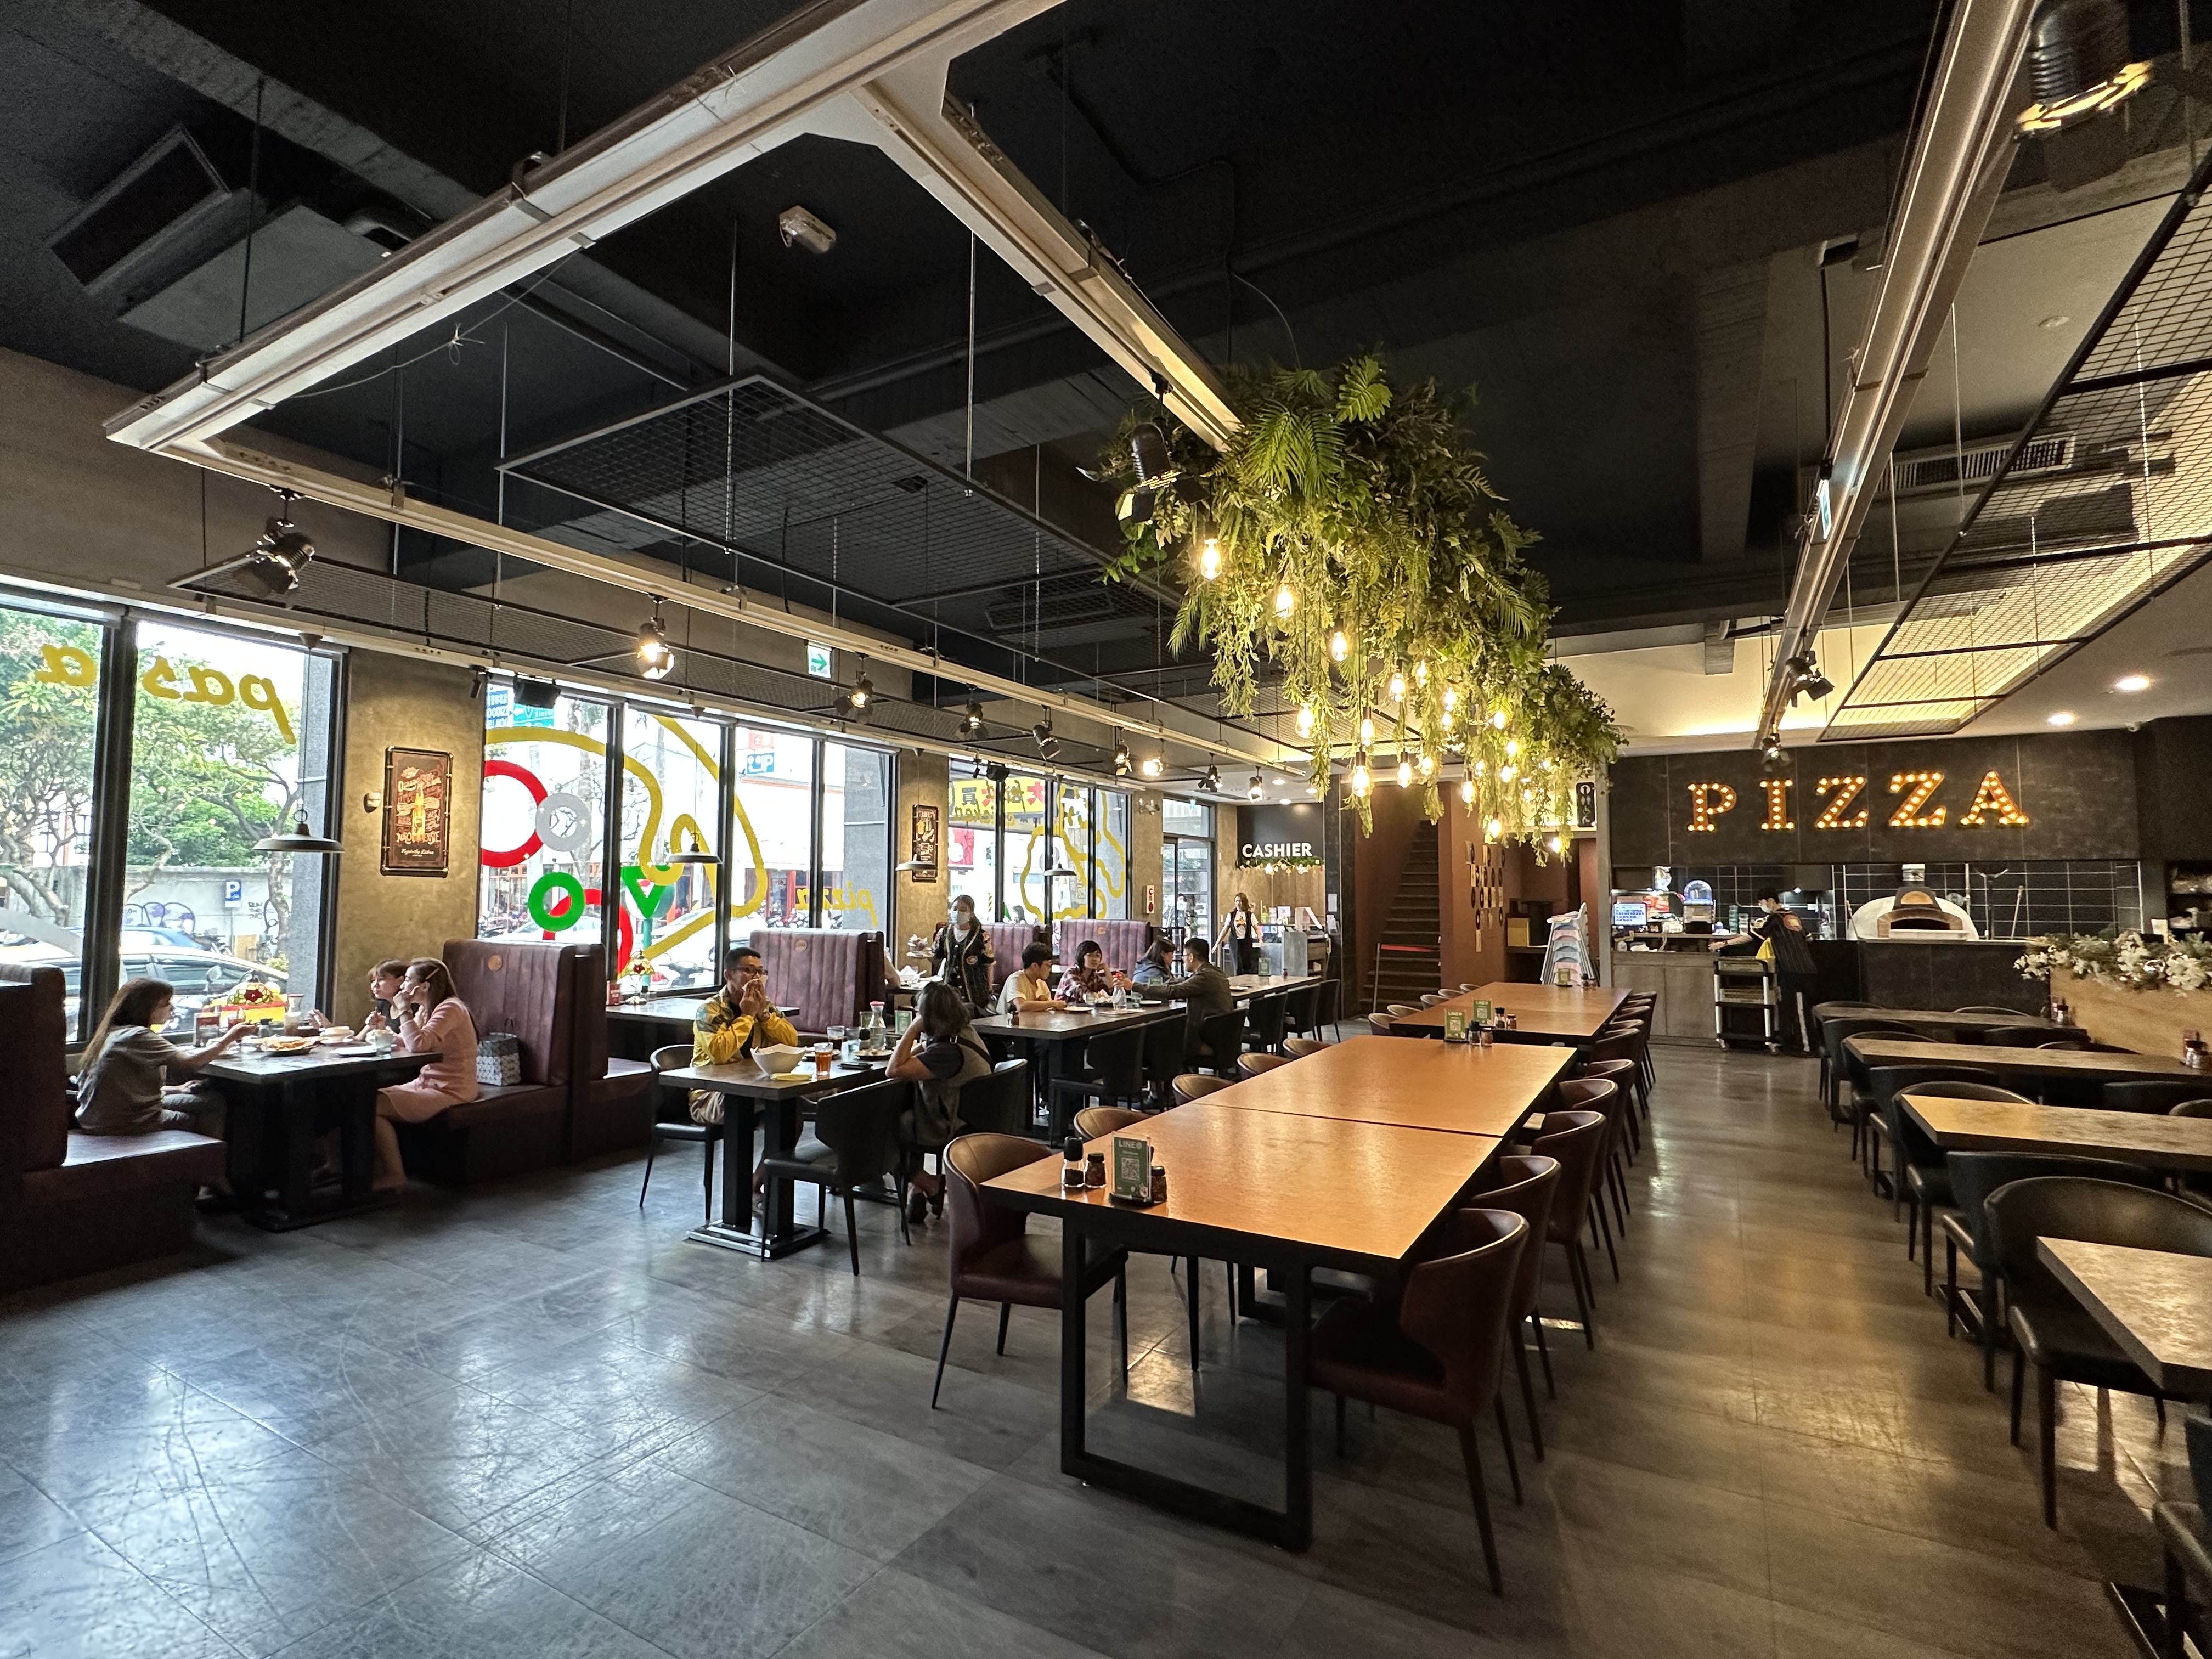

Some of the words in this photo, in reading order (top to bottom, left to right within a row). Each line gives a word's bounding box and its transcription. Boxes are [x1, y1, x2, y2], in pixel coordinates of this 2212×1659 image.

[1687, 770, 2029, 832] PIZZA
[1242, 843, 1313, 858] CASHIER
[226, 881, 240, 899] P
